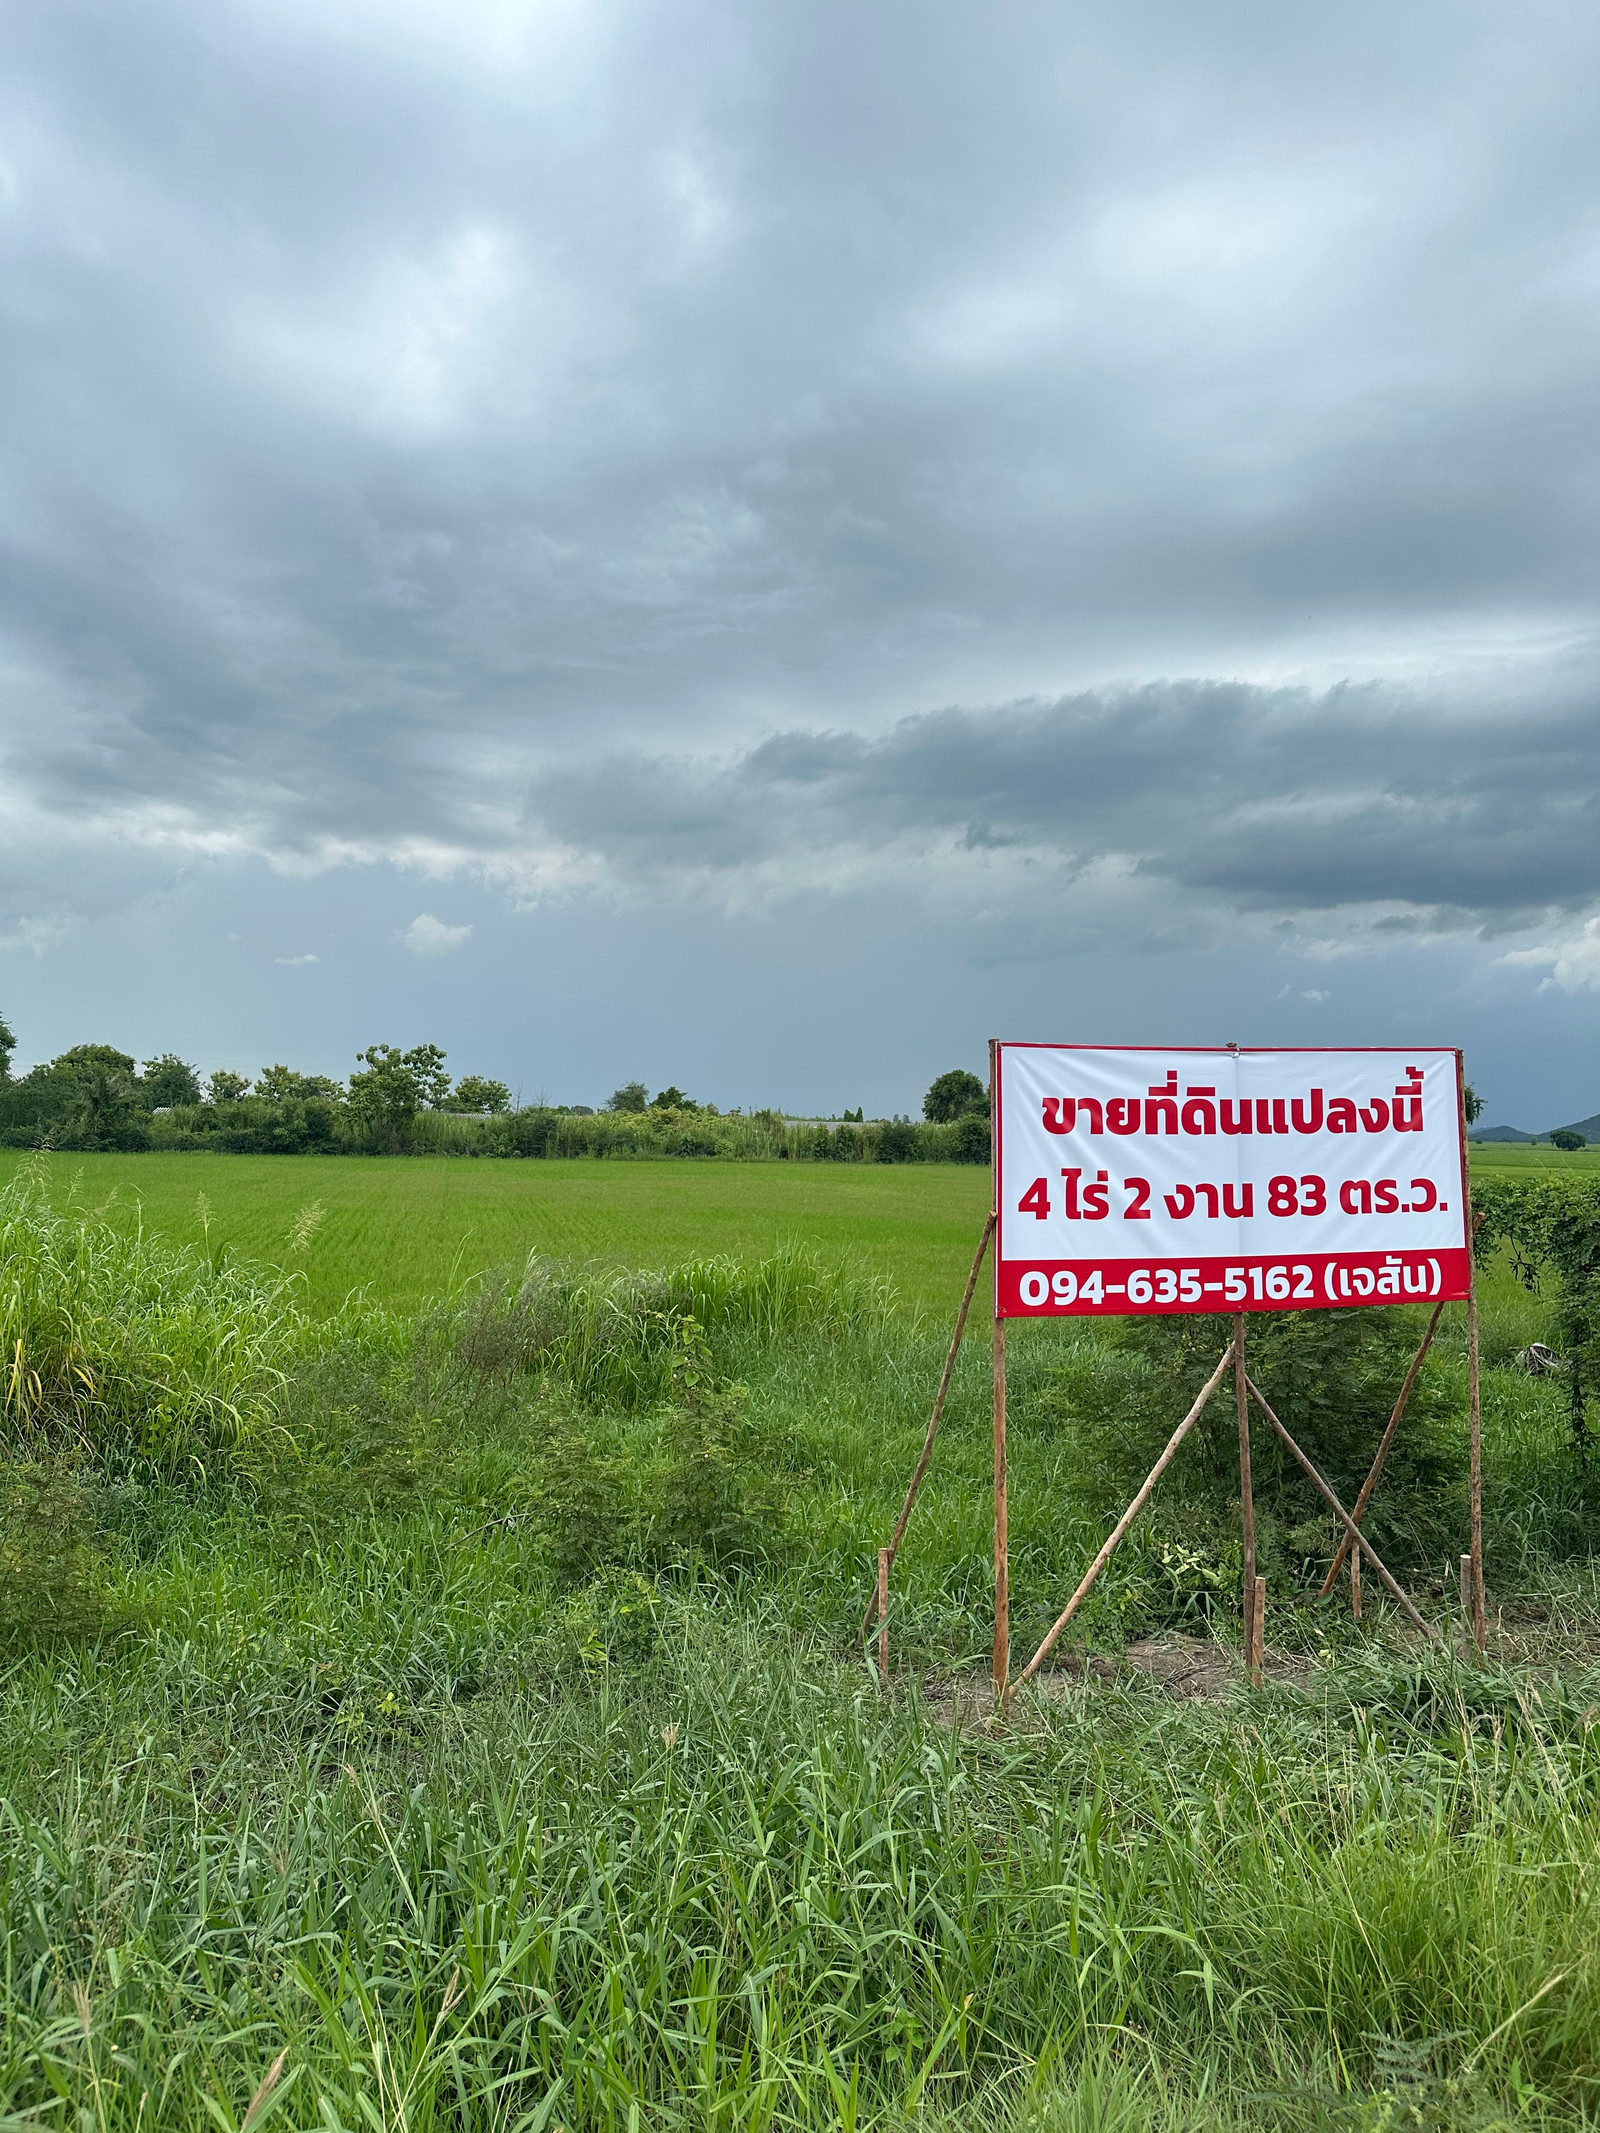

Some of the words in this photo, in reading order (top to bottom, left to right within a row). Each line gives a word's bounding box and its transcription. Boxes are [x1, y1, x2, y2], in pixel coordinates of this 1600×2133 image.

[1042, 1066, 1424, 1136] ขายที่ดินแปลงนี้
[1018, 1177, 1051, 1220] 4
[1061, 1167, 1110, 1221] ไร่
[1123, 1177, 1151, 1220] 2
[1163, 1183, 1254, 1220] งาน
[1267, 1174, 1327, 1217] 83
[1339, 1178, 1448, 1215] ตร.ว.
[1019, 1264, 1314, 1307] 094-635-5162
[1323, 1255, 1442, 1301] (เจสัน)
